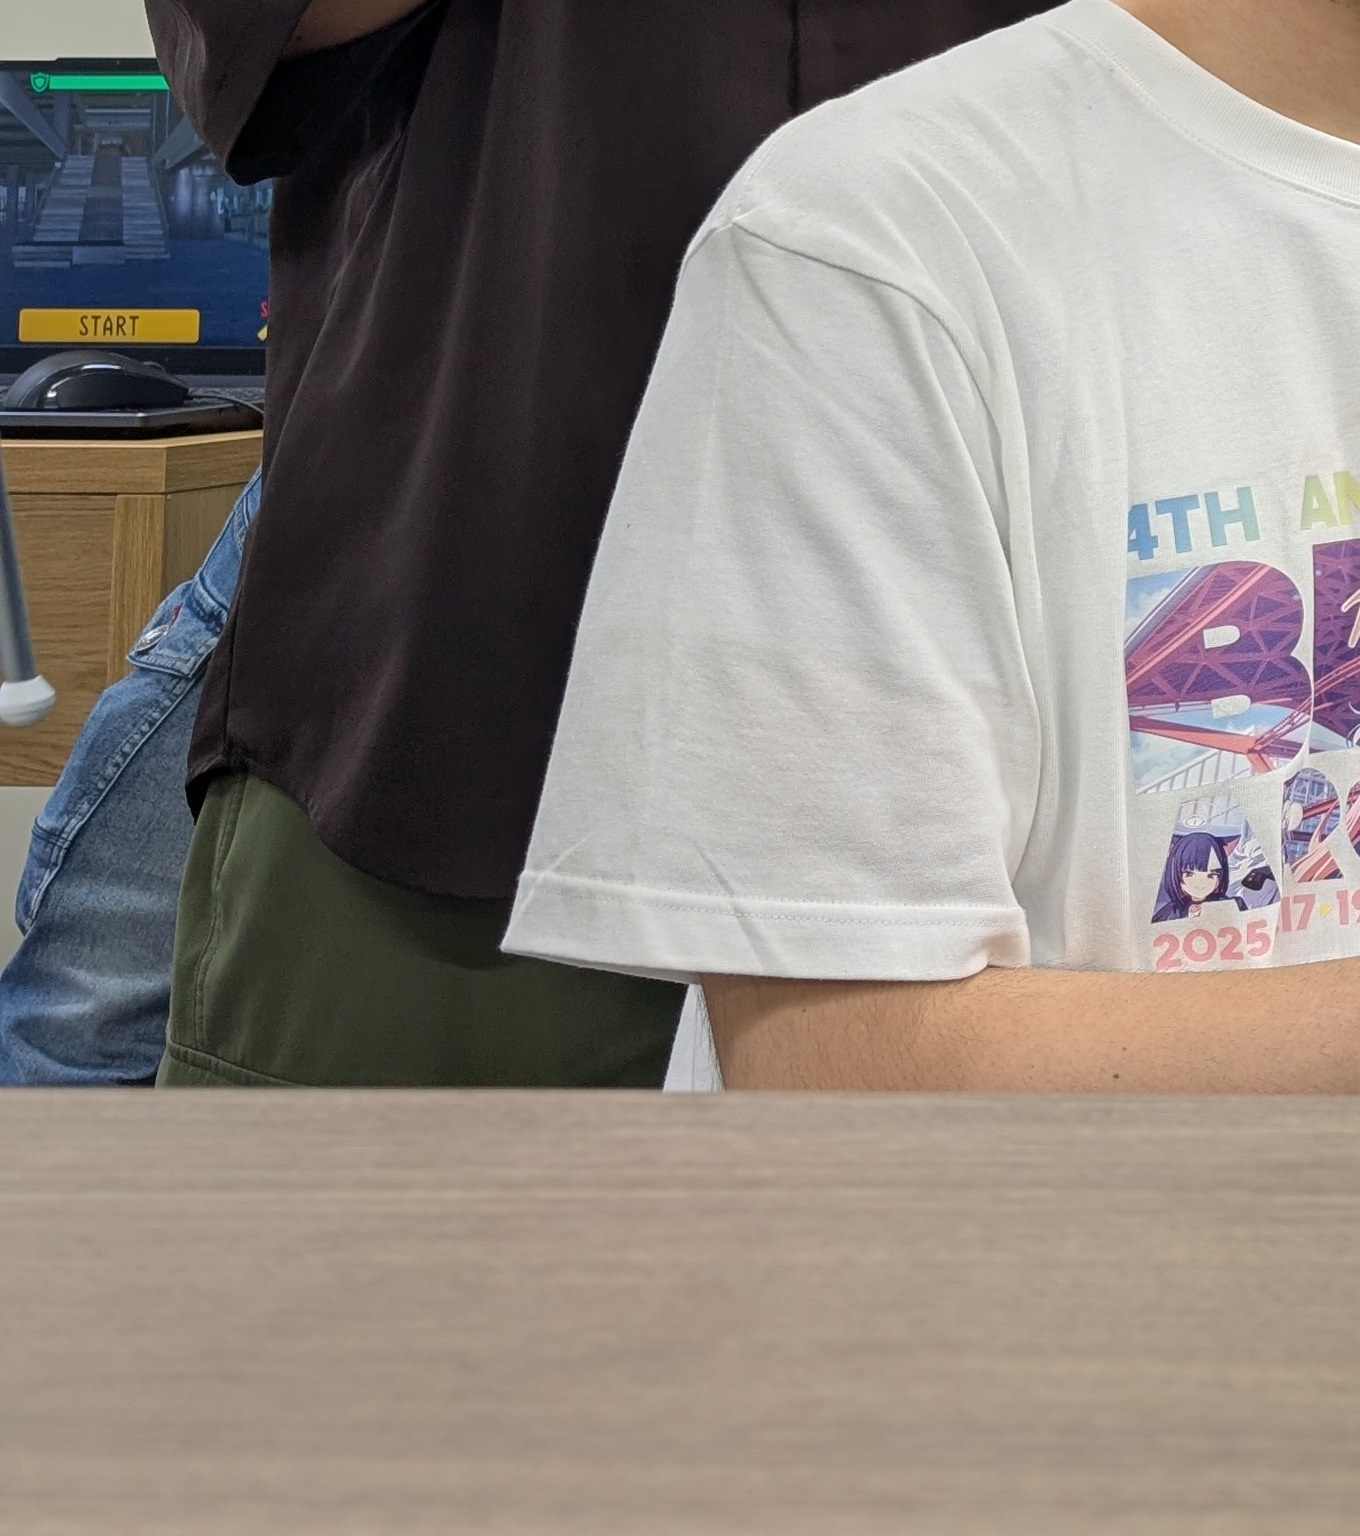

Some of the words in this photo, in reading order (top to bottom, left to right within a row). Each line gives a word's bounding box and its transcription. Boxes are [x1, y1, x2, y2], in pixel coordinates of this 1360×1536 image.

[79, 315, 139, 337] START
[1127, 486, 1261, 561] 4TH
[1153, 918, 1273, 969] 2025
